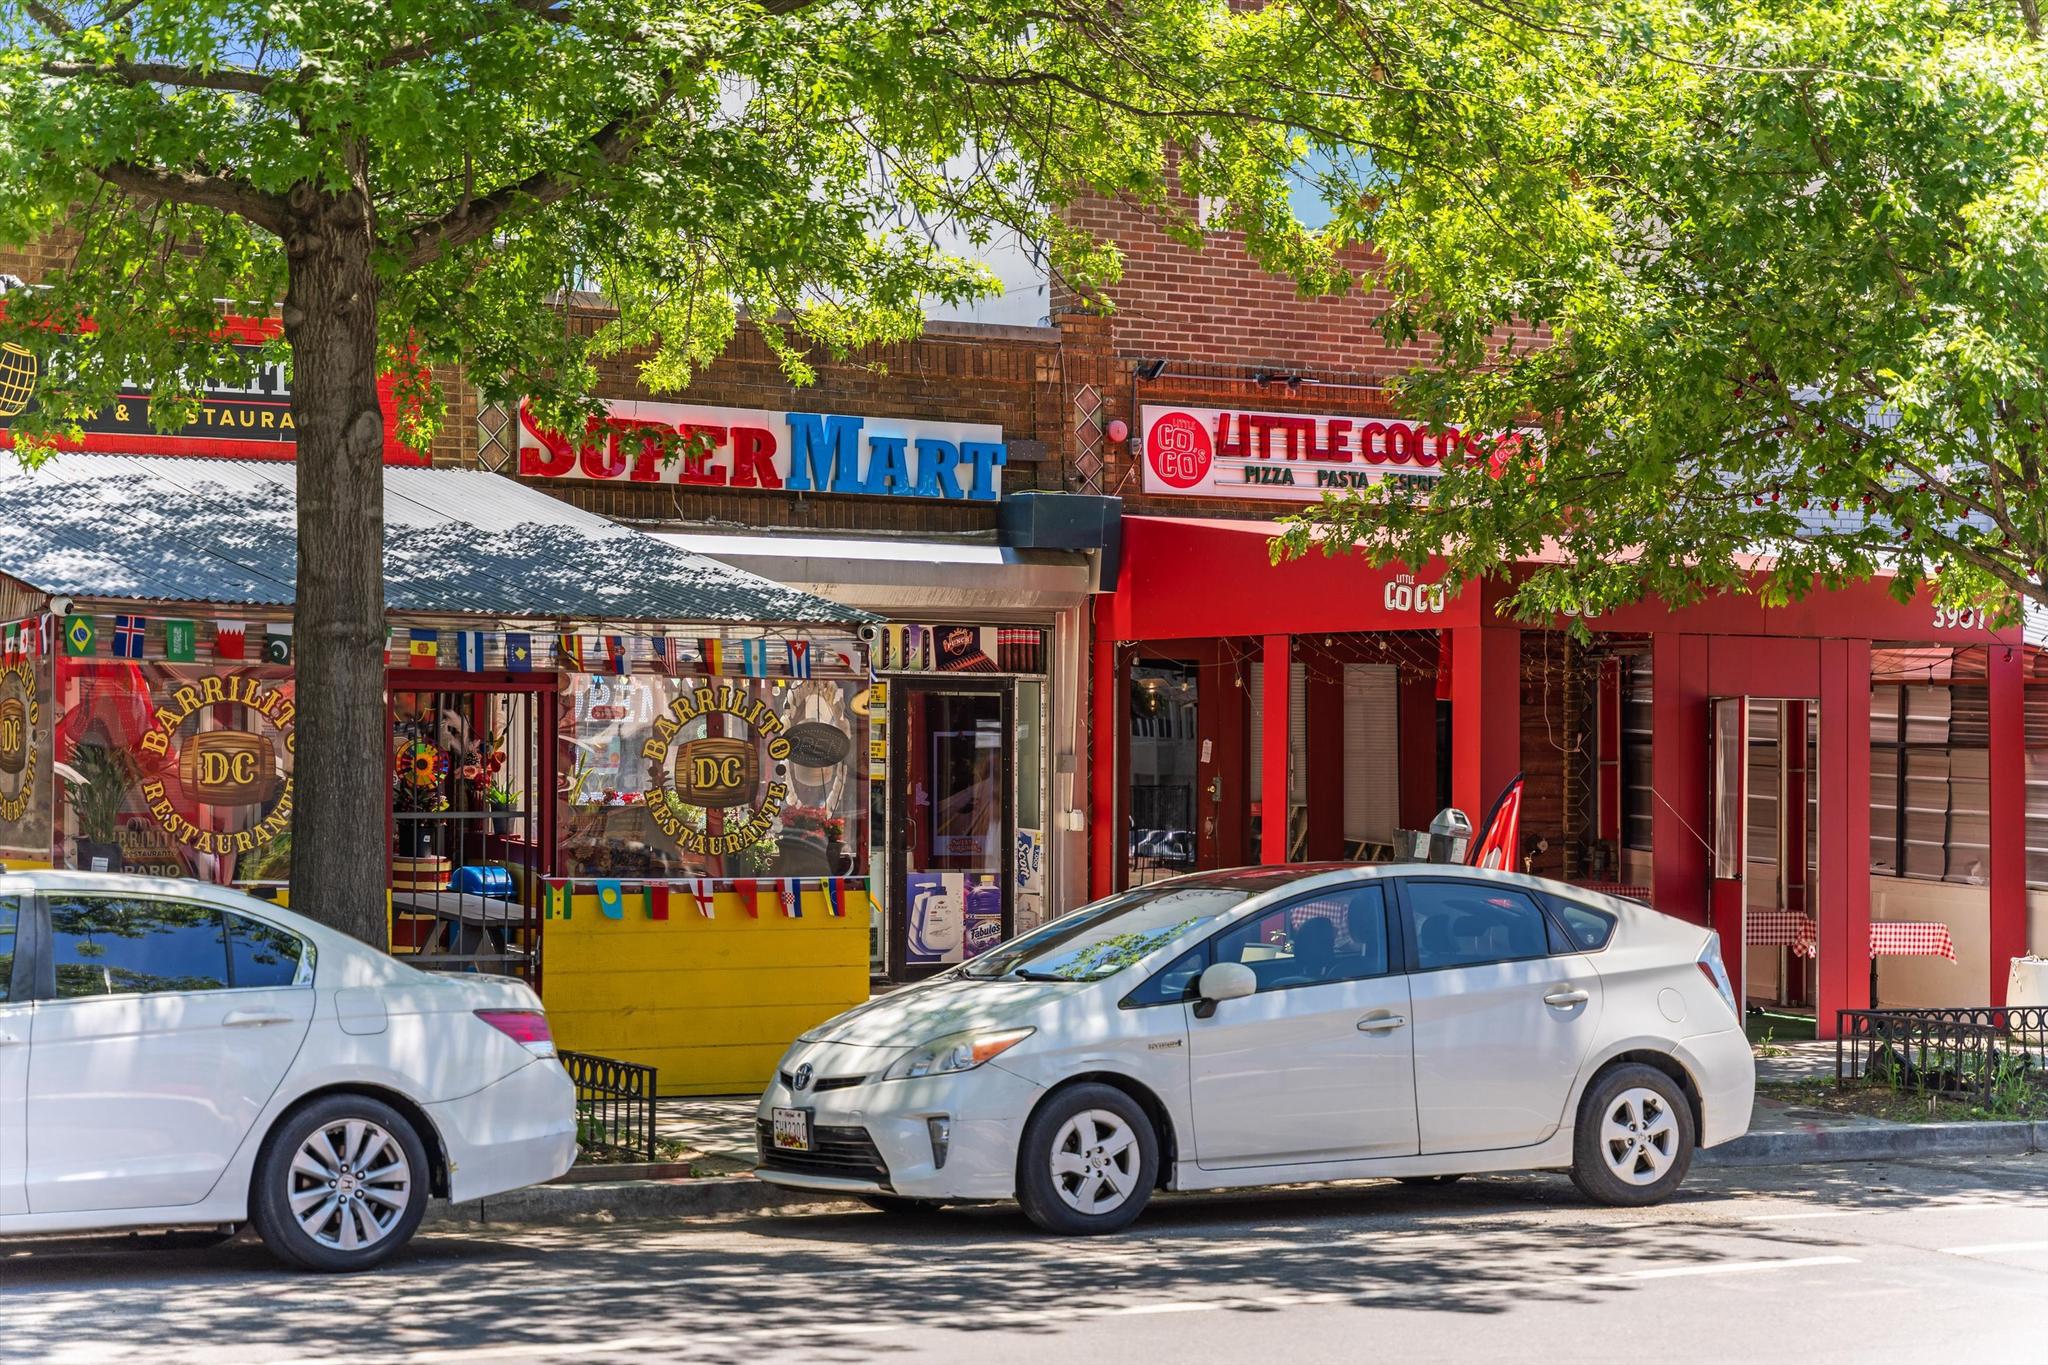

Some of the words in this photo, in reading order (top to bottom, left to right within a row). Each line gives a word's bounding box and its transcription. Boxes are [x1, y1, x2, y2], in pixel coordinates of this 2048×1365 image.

[115, 403, 131, 421] &
[785, 413, 1007, 500] MART
[1215, 412, 1354, 464] LITTLE
[1361, 421, 1485, 470] COCOS
[1244, 465, 1296, 487] PIZZA
[1317, 469, 1370, 491] PASTA
[1384, 577, 1453, 613] COCOS
[1395, 573, 1415, 585] LITTLE
[3, 718, 21, 752] DC
[642, 685, 792, 764] BARRILITO
[200, 751, 255, 784] DC
[693, 756, 742, 789] DC
[643, 782, 788, 857] RESTAURANTE
[1018, 842, 1030, 880] Scott
